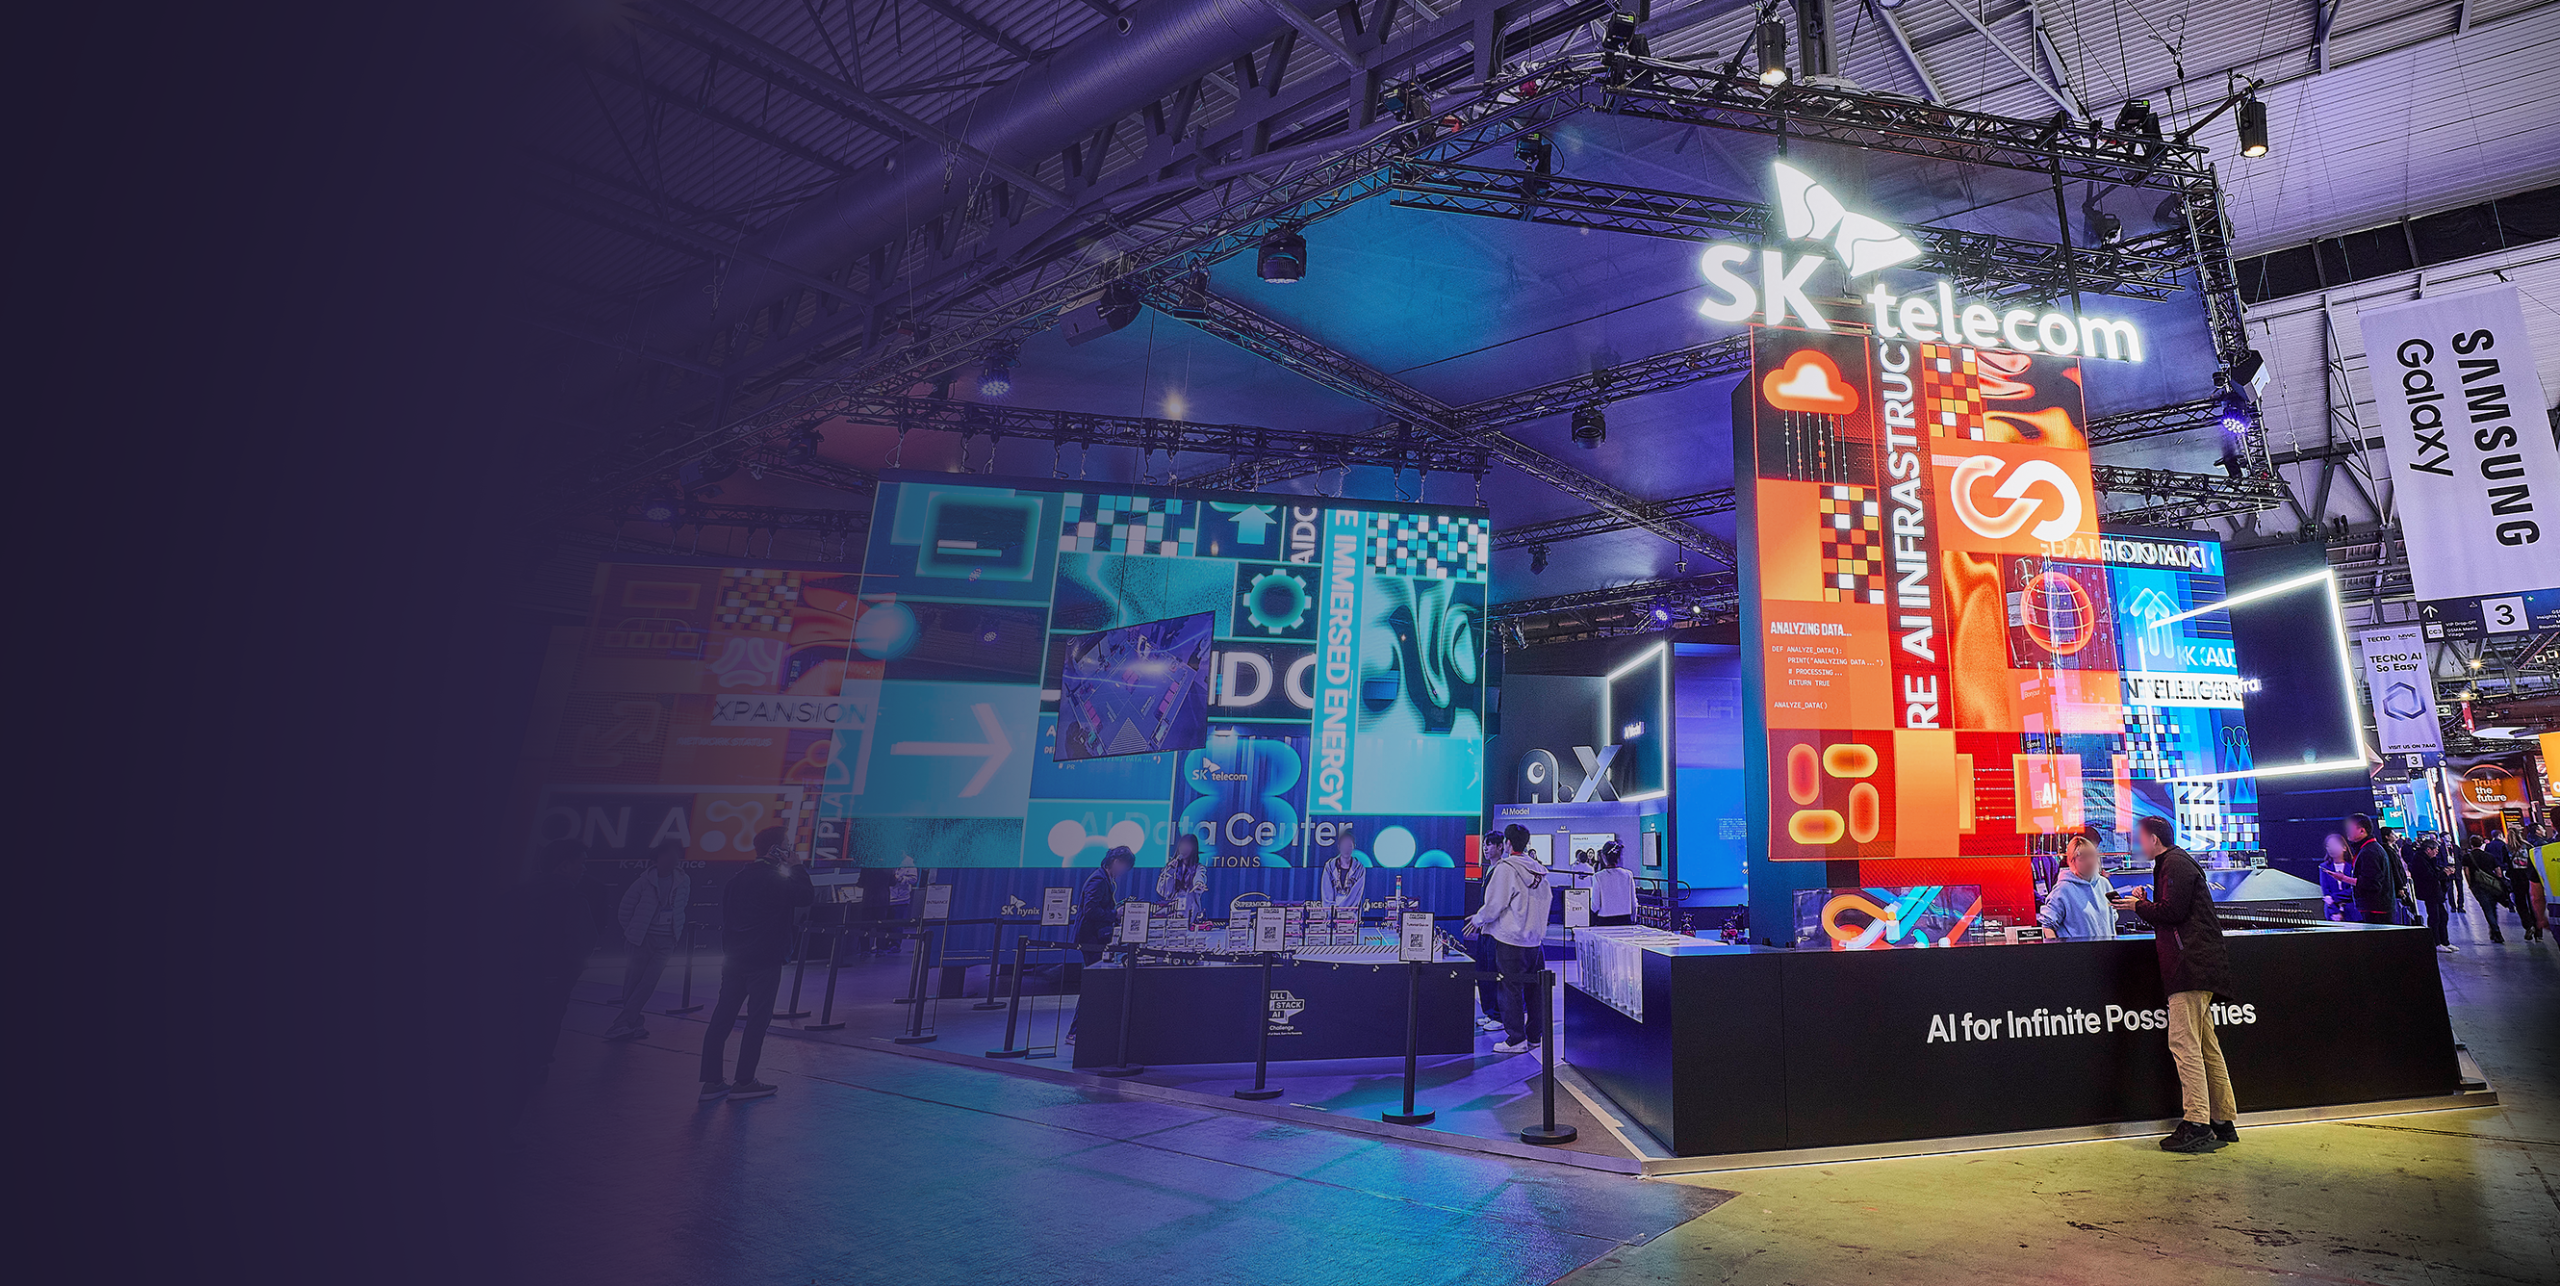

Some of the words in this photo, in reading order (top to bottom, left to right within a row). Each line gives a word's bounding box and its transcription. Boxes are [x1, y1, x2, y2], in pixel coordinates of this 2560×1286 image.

[1699, 245, 1831, 331] SK
[1866, 281, 2143, 362] telecom
[2397, 339, 2453, 476] Galaxy
[2452, 329, 2540, 546] SAMSUNG
[1325, 535, 1357, 685] IMMERSED
[2494, 604, 2516, 625] 3
[1771, 621, 1820, 636] ANALYZING
[1821, 623, 1852, 636] DATA...
[1900, 616, 1935, 662] AI
[2369, 653, 2407, 663] TECNO
[2411, 652, 2422, 660] AI
[2393, 663, 2418, 671] Easy
[1318, 688, 1348, 812] ENERGY
[2411, 756, 2418, 765] 3
[1192, 769, 1208, 781] SK
[1211, 771, 1248, 782] telecom
[2472, 778, 2501, 787] Trust
[2475, 786, 2493, 795] the
[2476, 794, 2507, 803] future
[1225, 812, 1353, 847] Center
[1001, 906, 1014, 915] SK
[1016, 907, 1040, 917] hynix
[1927, 1013, 1956, 1043] AI
[1961, 1013, 2002, 1041] for
[2007, 1007, 2101, 1038] Infinite
[2105, 1002, 2257, 1032] Possties
